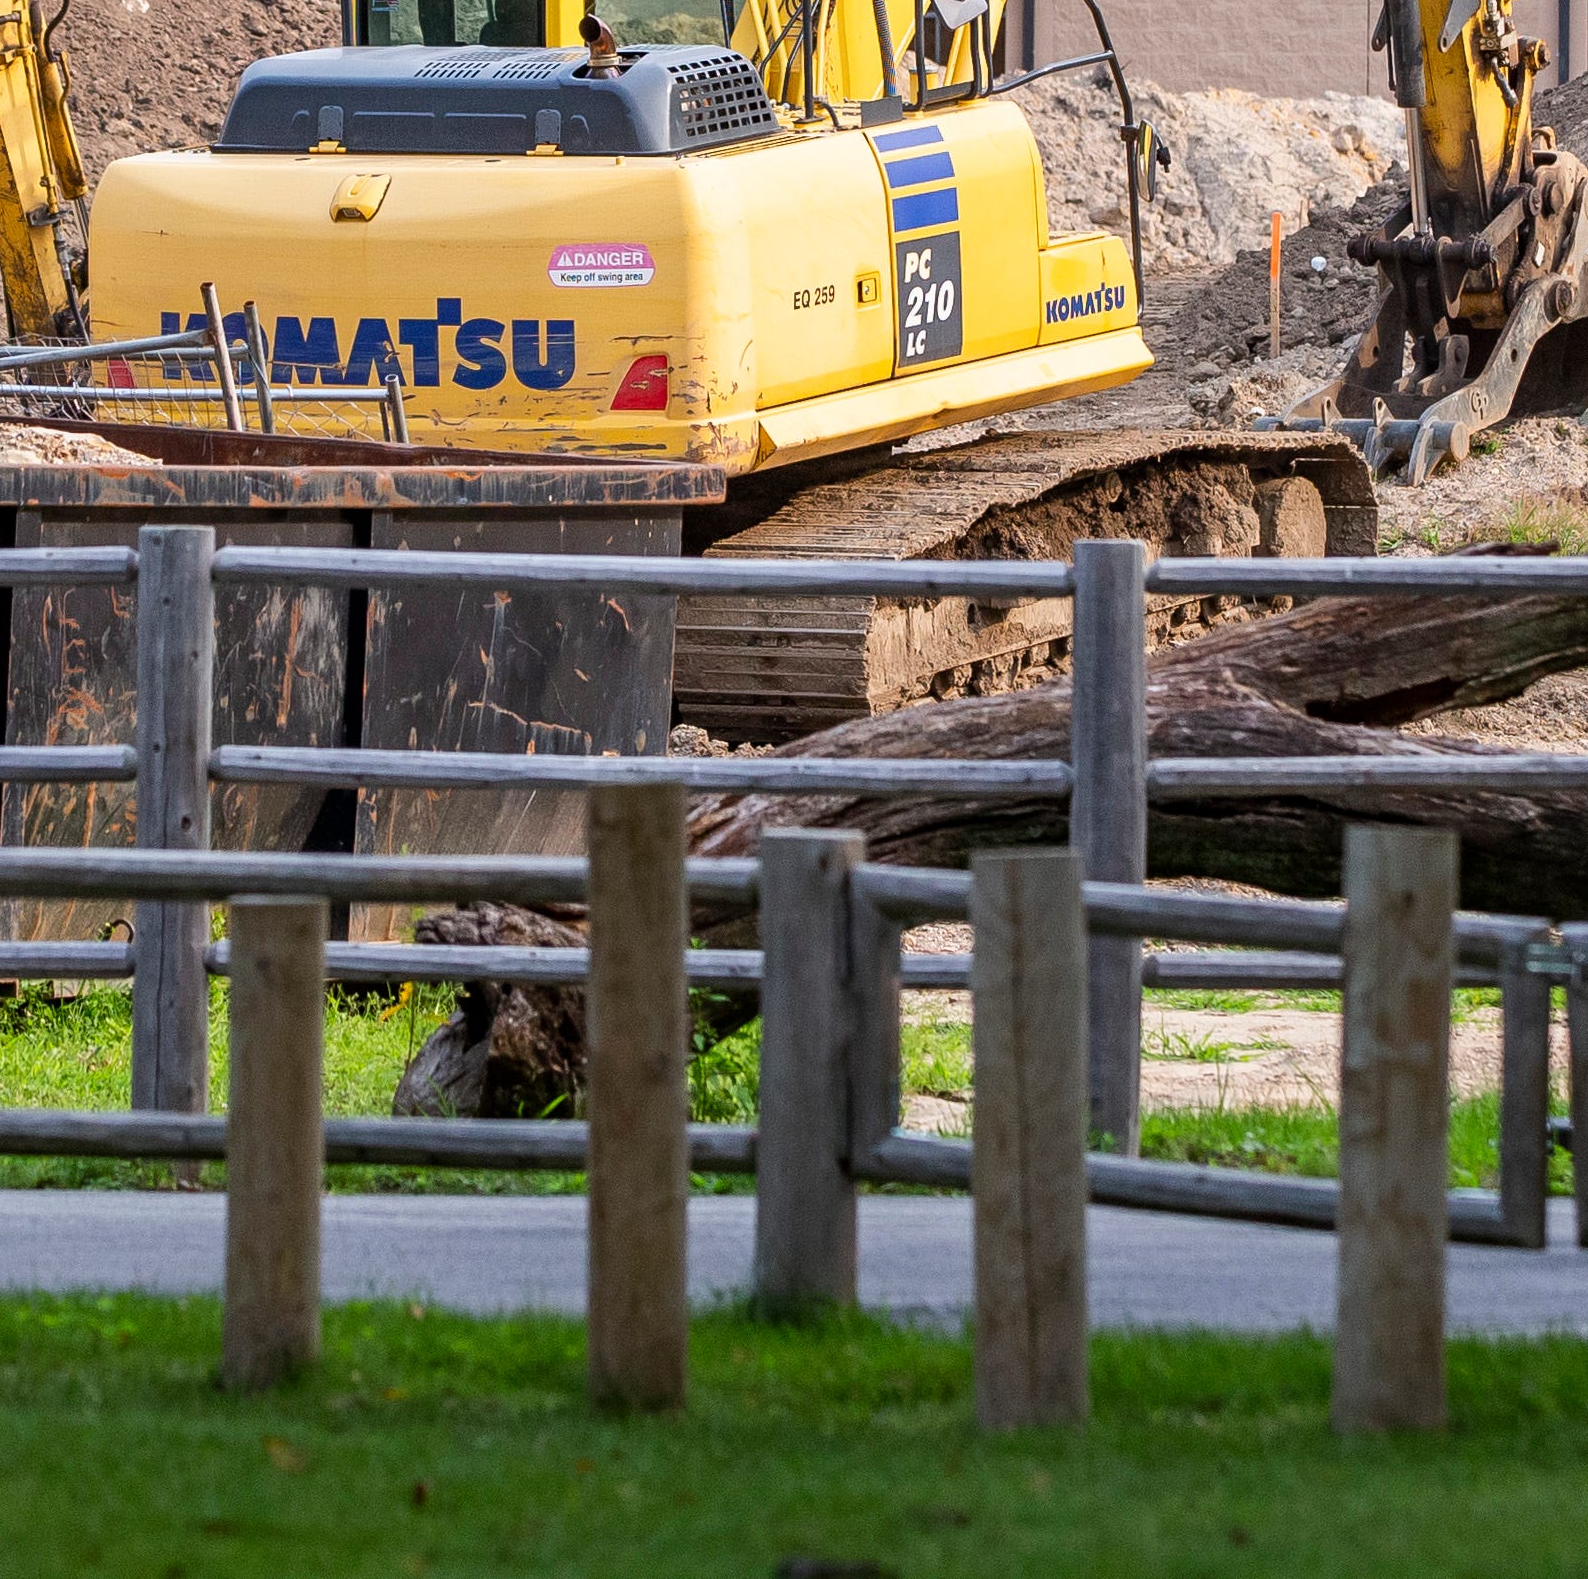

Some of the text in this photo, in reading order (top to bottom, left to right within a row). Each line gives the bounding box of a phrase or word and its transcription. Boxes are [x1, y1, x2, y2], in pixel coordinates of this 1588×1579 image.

[574, 252, 644, 267] DANGER
[904, 248, 932, 283] PC
[560, 272, 643, 284] Keep off swing area
[793, 285, 836, 310] EQ 259
[905, 280, 955, 328] 210
[1046, 282, 1125, 324] KOMATSU
[161, 298, 576, 390] KOMATSU
[906, 330, 927, 357] LC
